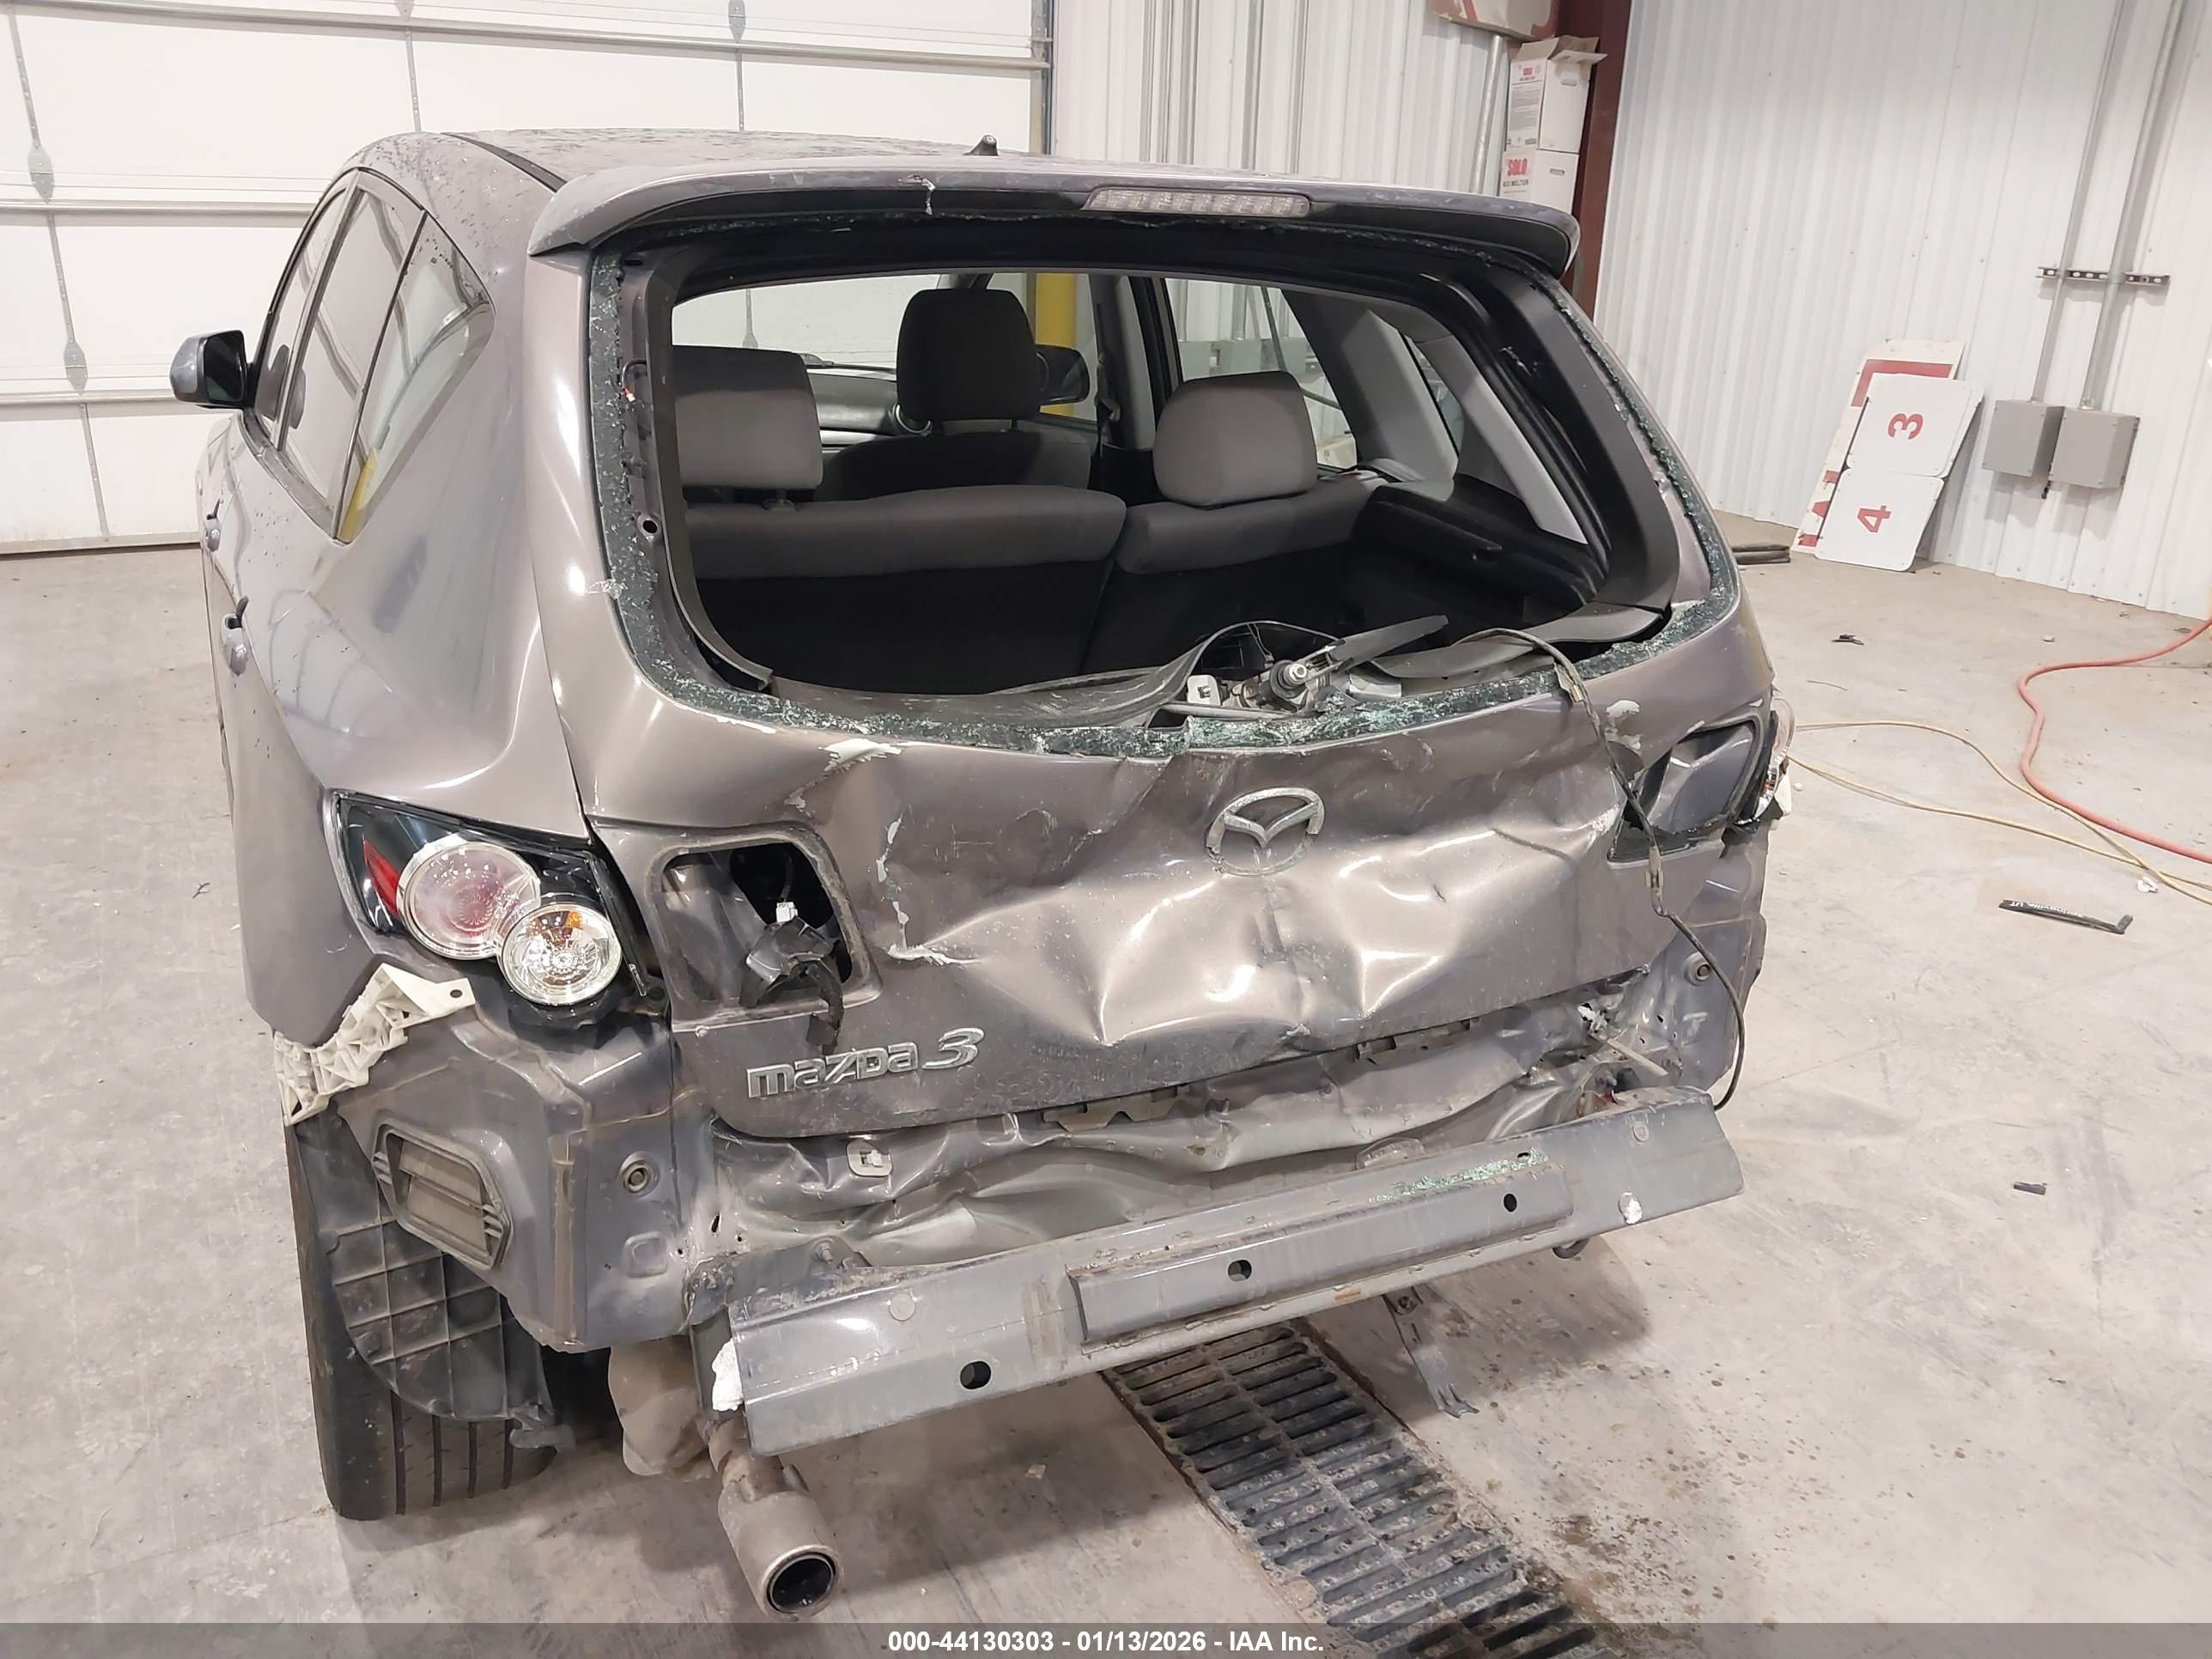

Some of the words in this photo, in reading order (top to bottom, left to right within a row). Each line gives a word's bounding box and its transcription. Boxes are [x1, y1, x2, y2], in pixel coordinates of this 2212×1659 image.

[1507, 158, 1528, 176] SOLO
[1888, 413, 1923, 441] 3
[1856, 506, 1890, 533] 4
[921, 1027, 985, 1070] 3
